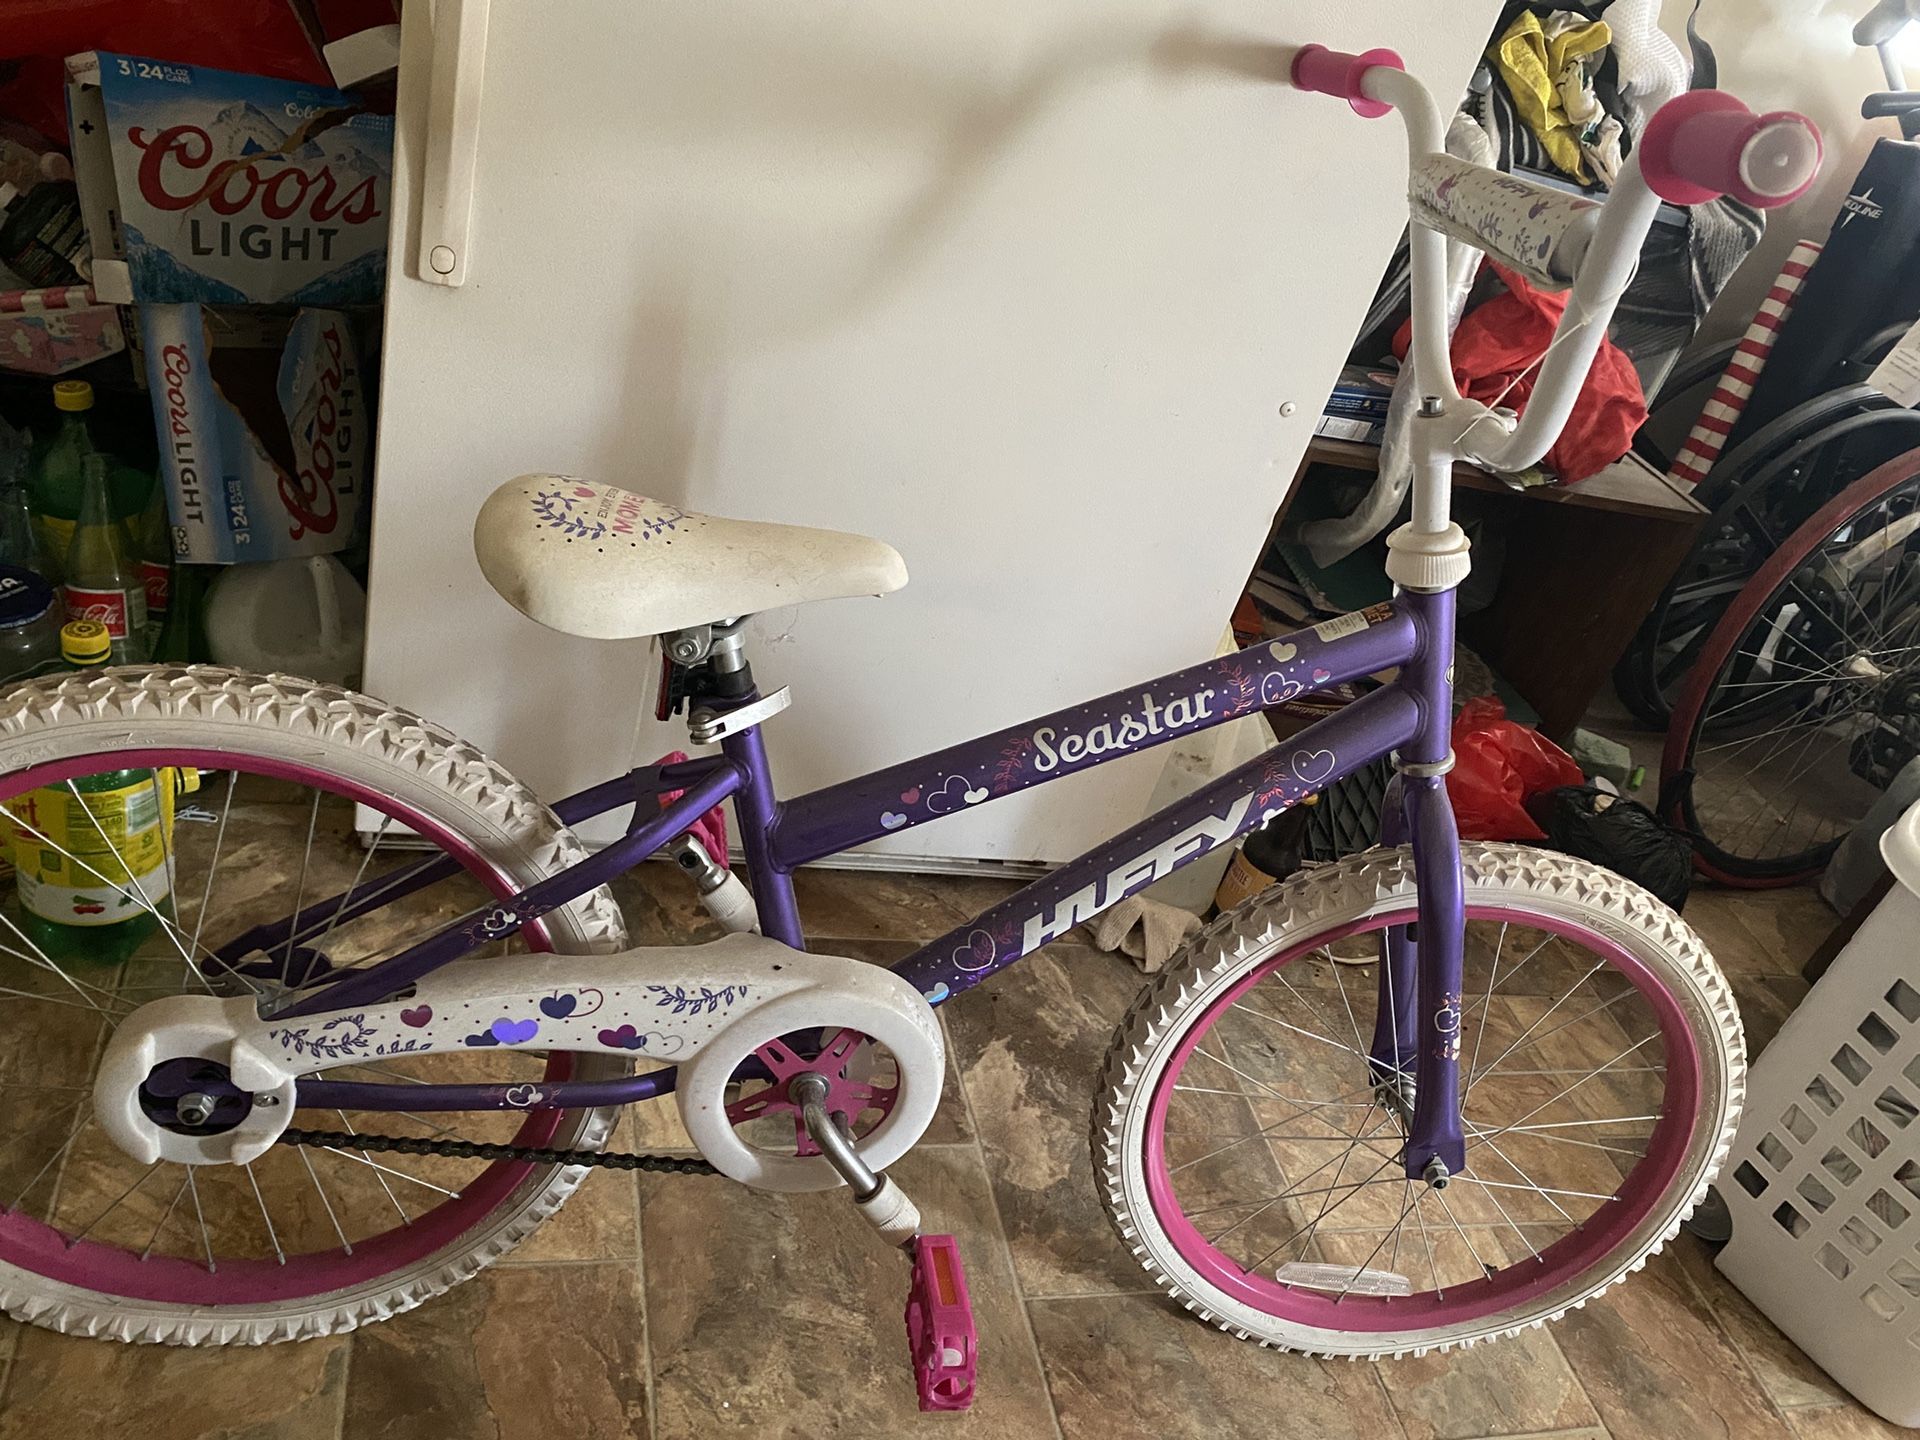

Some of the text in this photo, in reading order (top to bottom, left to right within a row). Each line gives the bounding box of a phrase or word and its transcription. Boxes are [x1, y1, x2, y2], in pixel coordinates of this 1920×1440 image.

[128, 124, 381, 224] Coors
[191, 219, 338, 262] LIGHT
[162, 343, 193, 437] Coors
[277, 321, 343, 541] Coors
[336, 366, 356, 496] LIGHT
[176, 442, 204, 524] LIGHT
[1033, 688, 1215, 772] Seastar
[1021, 791, 1256, 957] HUFFY
